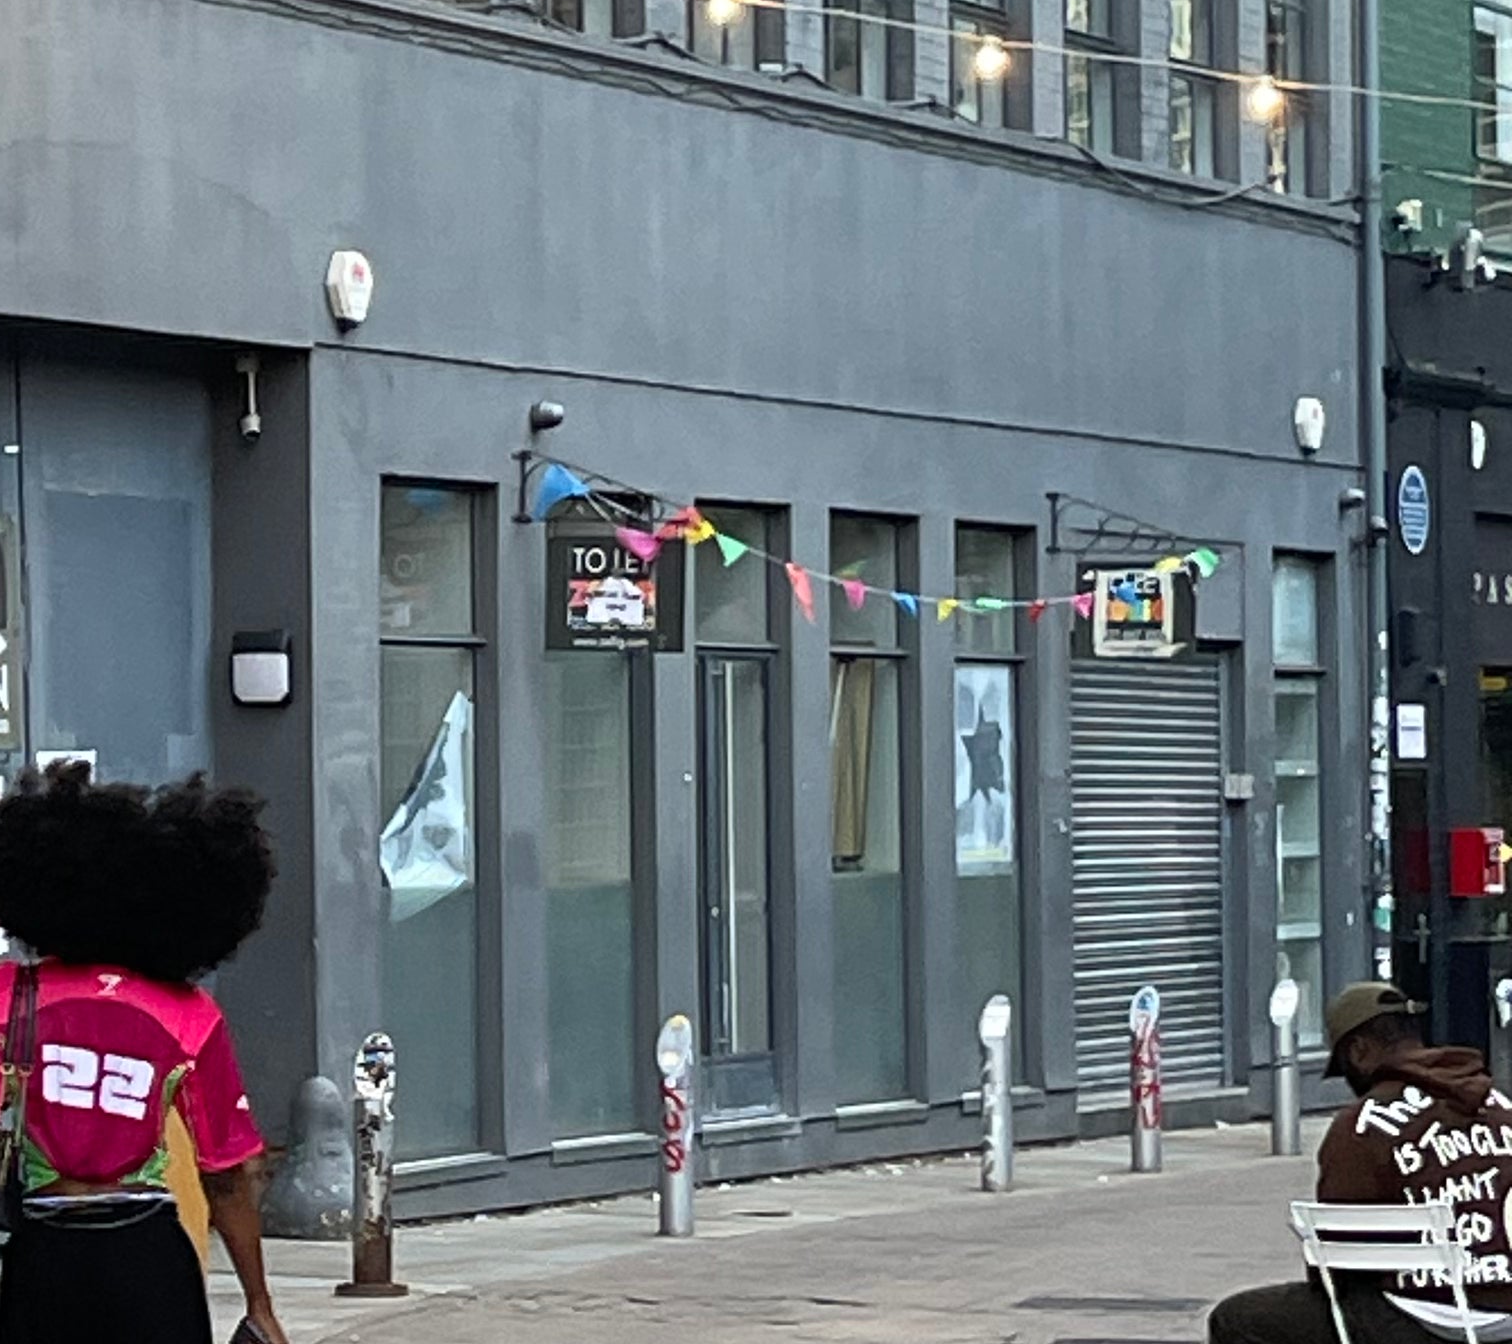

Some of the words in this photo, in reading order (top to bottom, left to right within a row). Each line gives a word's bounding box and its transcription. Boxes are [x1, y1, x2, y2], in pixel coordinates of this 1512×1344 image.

[573, 547, 607, 573] TO
[41, 1043, 155, 1121] 22
[1355, 1086, 1433, 1137] The
[1393, 1142, 1424, 1175] IS
[1455, 1212, 1493, 1247] GO
[1397, 1250, 1512, 1289] URHER
